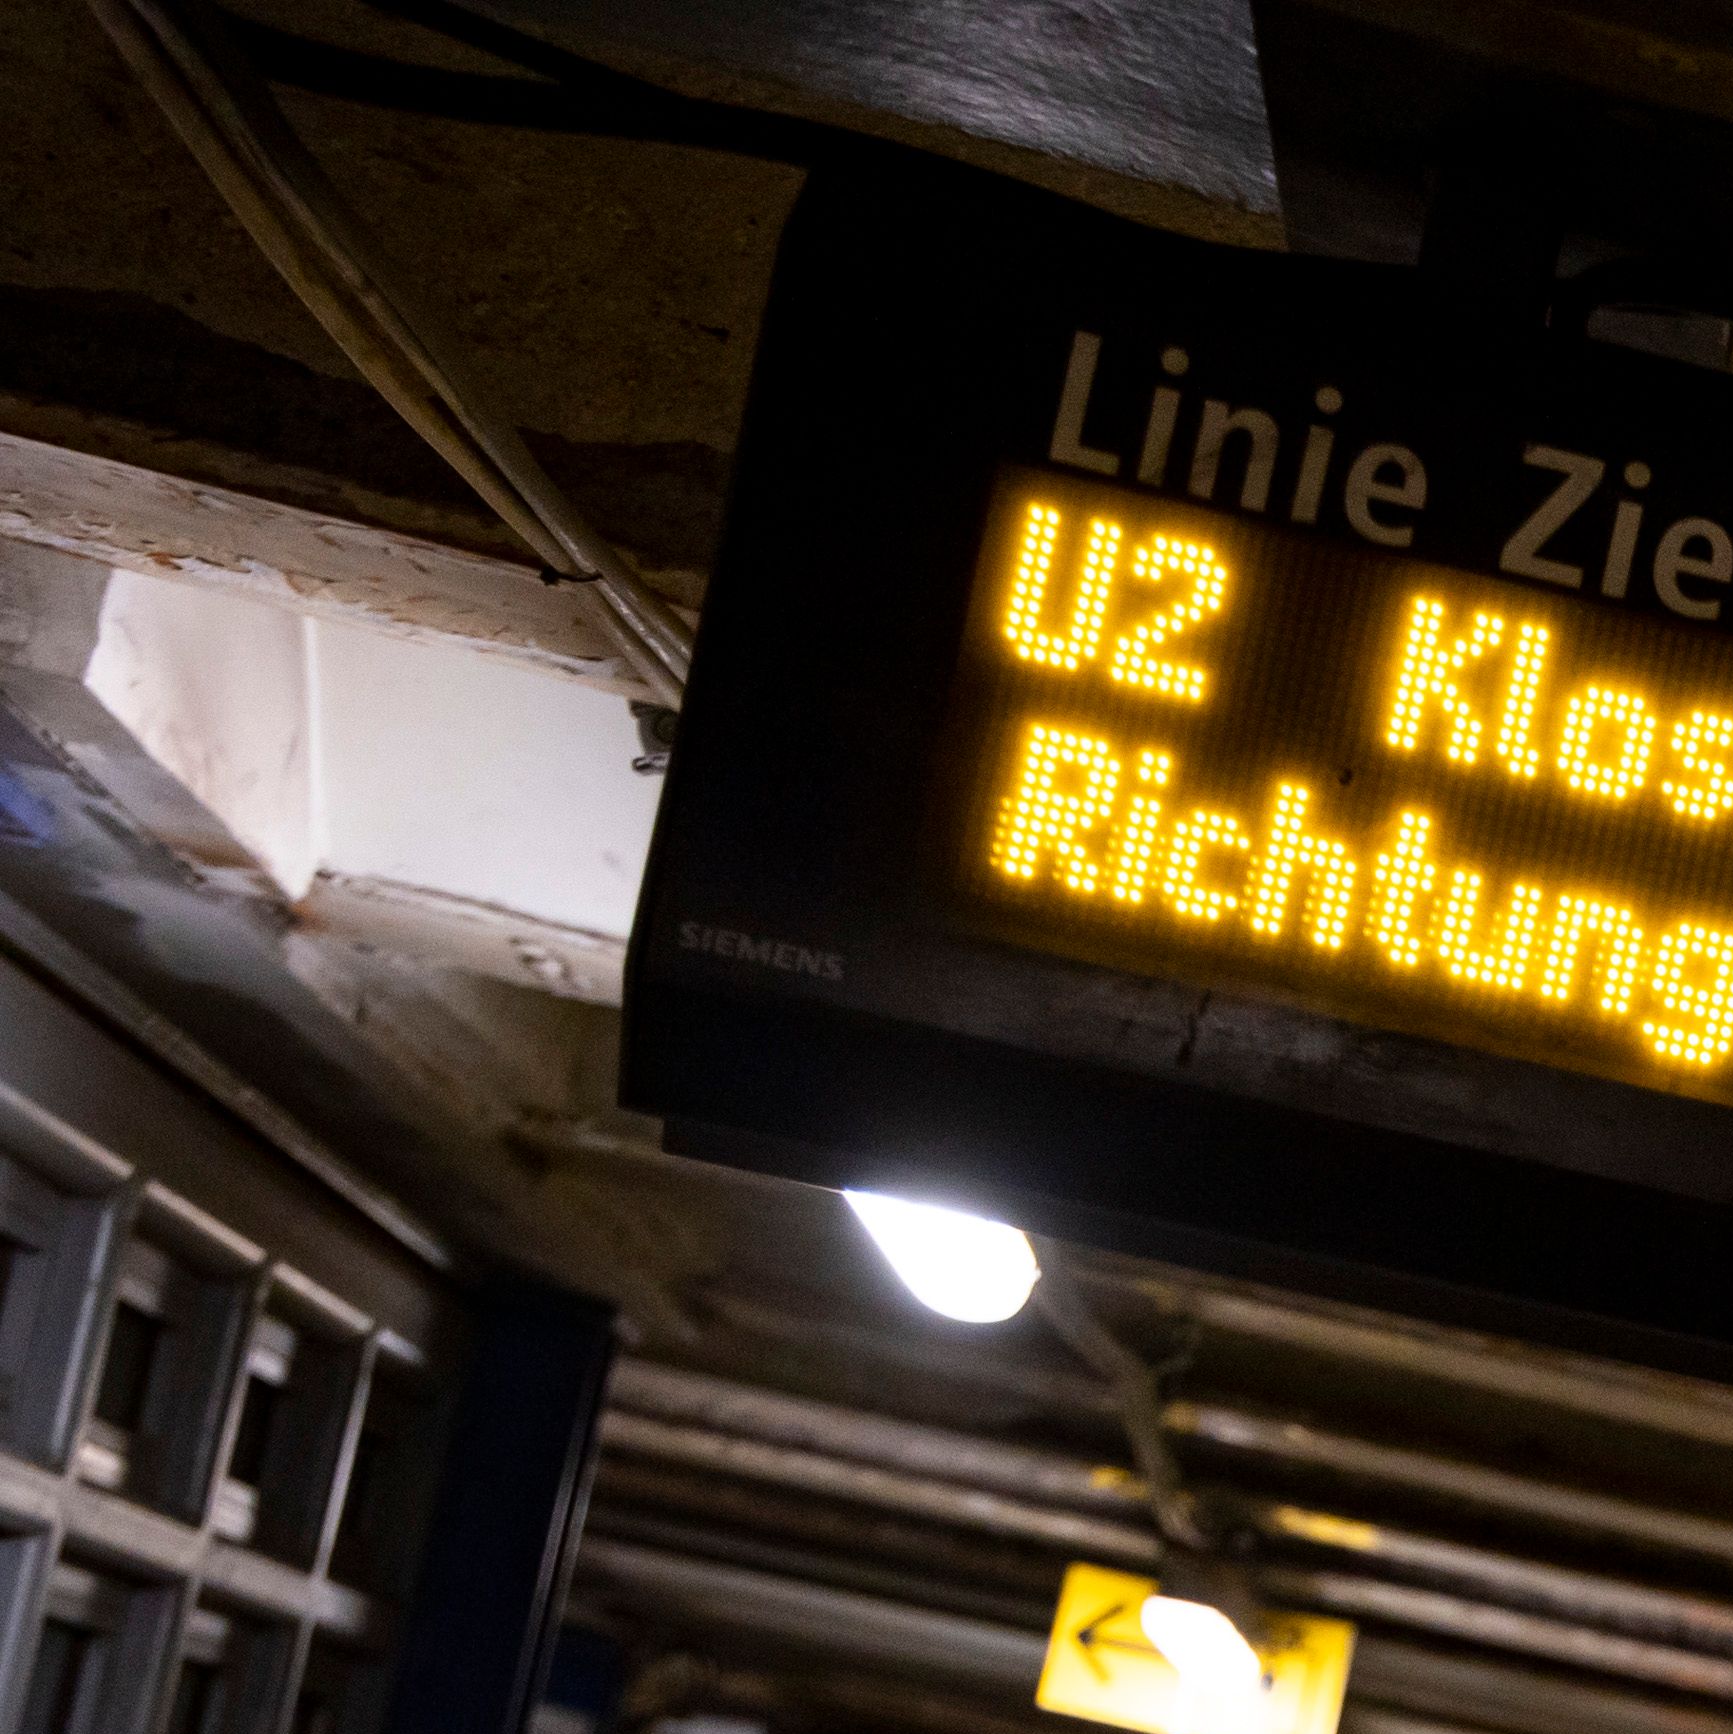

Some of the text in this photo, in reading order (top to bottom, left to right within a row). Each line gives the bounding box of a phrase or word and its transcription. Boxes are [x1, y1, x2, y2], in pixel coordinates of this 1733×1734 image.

[1048, 328, 1430, 548] Linie
[1002, 502, 1232, 701] U2
[679, 920, 846, 982] SIEMENS
